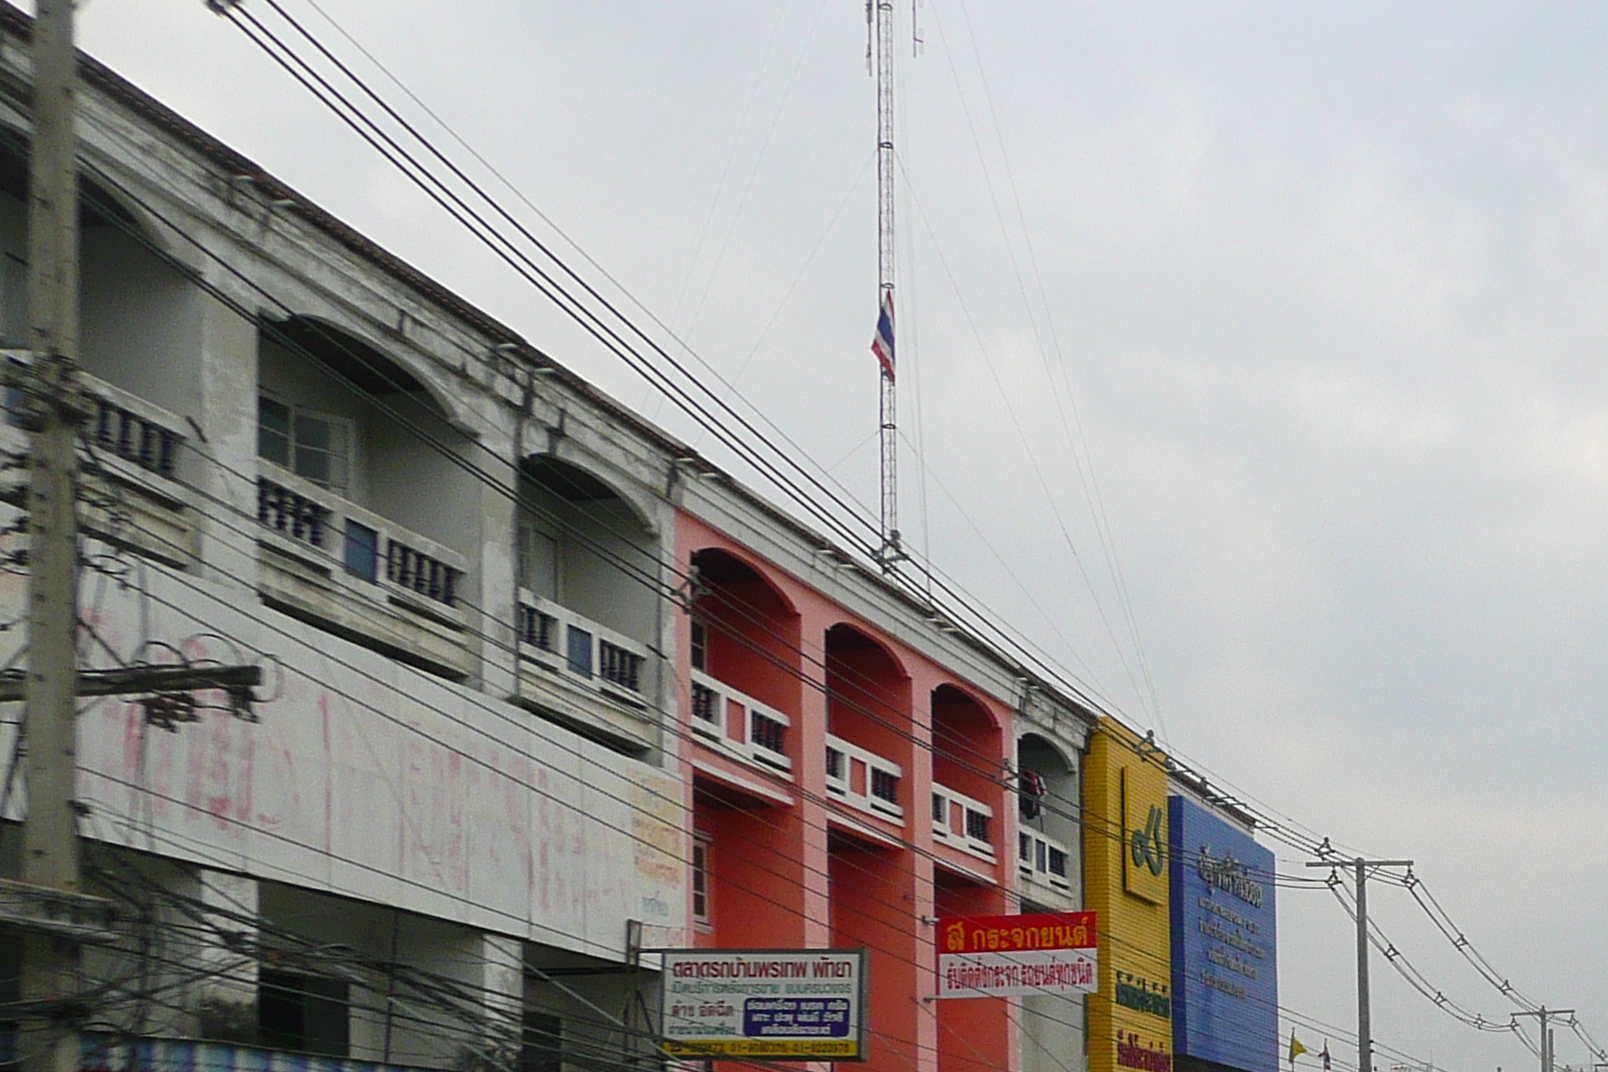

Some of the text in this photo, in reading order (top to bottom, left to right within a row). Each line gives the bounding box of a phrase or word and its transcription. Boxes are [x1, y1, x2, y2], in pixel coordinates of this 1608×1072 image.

[972, 917, 1089, 950] กระจกยนต์
[813, 957, 852, 978] พัทยา
